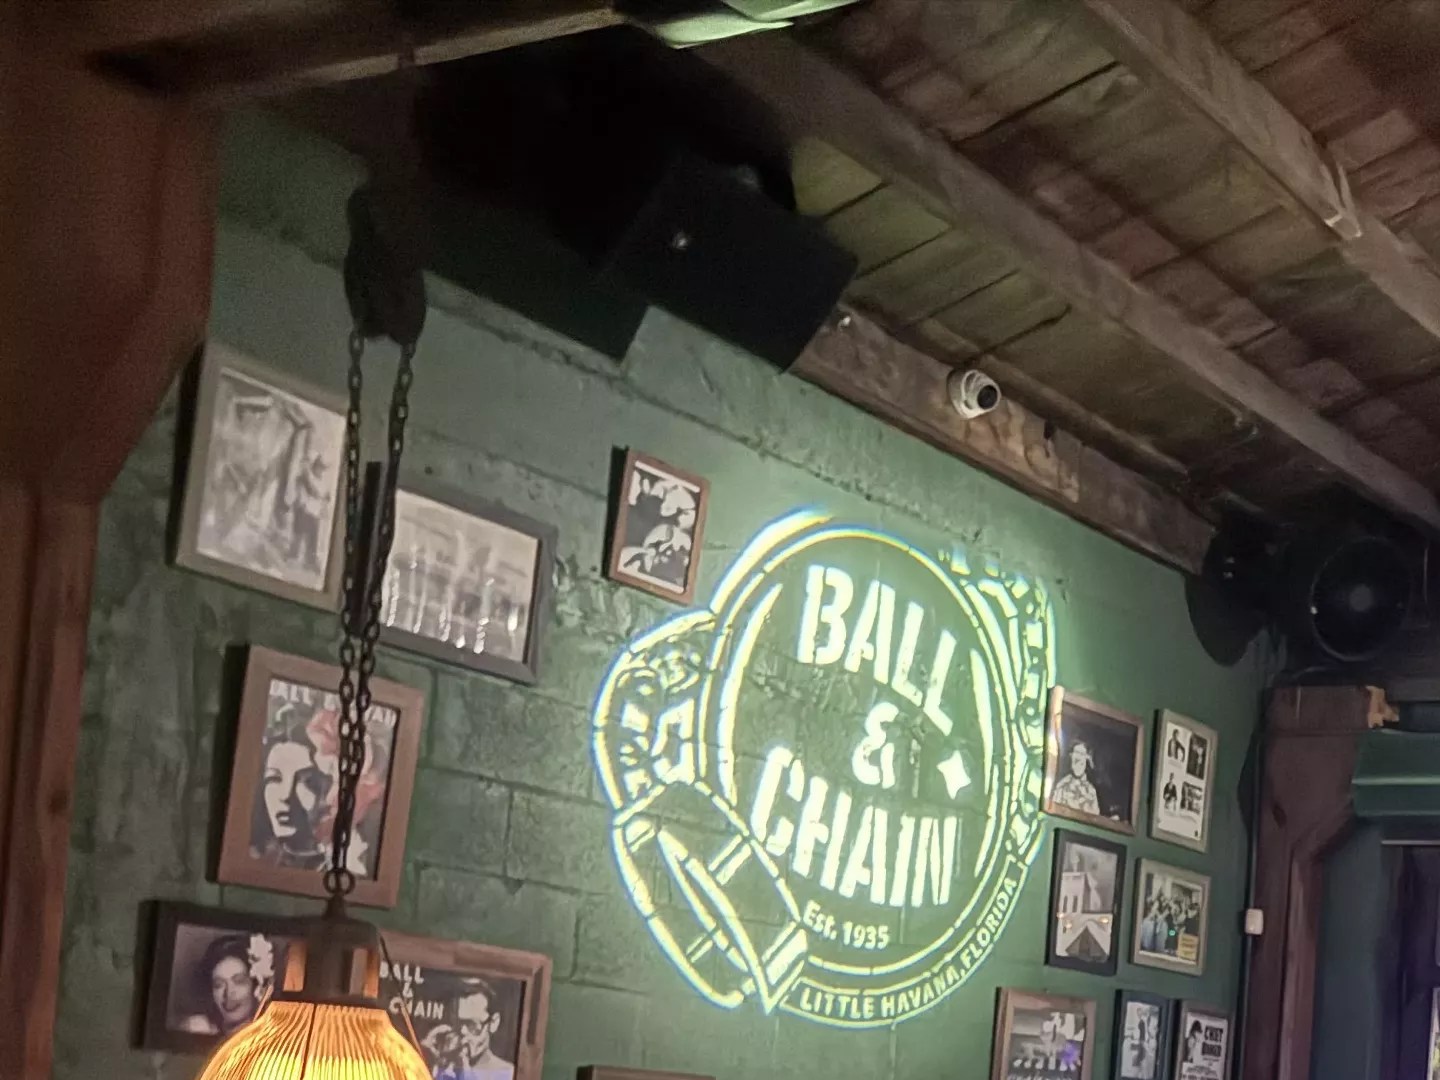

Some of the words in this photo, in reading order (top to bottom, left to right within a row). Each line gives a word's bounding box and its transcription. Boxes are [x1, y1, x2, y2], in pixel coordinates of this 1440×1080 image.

[799, 564, 956, 736] BALL
[851, 701, 898, 789] &
[750, 745, 958, 908] CHAIN
[800, 986, 875, 1019] LITTLE
[881, 963, 967, 1018] HAVANA,
[960, 877, 1018, 969] FLORIDA
[803, 899, 838, 941] Est.
[842, 920, 890, 950] 1935
